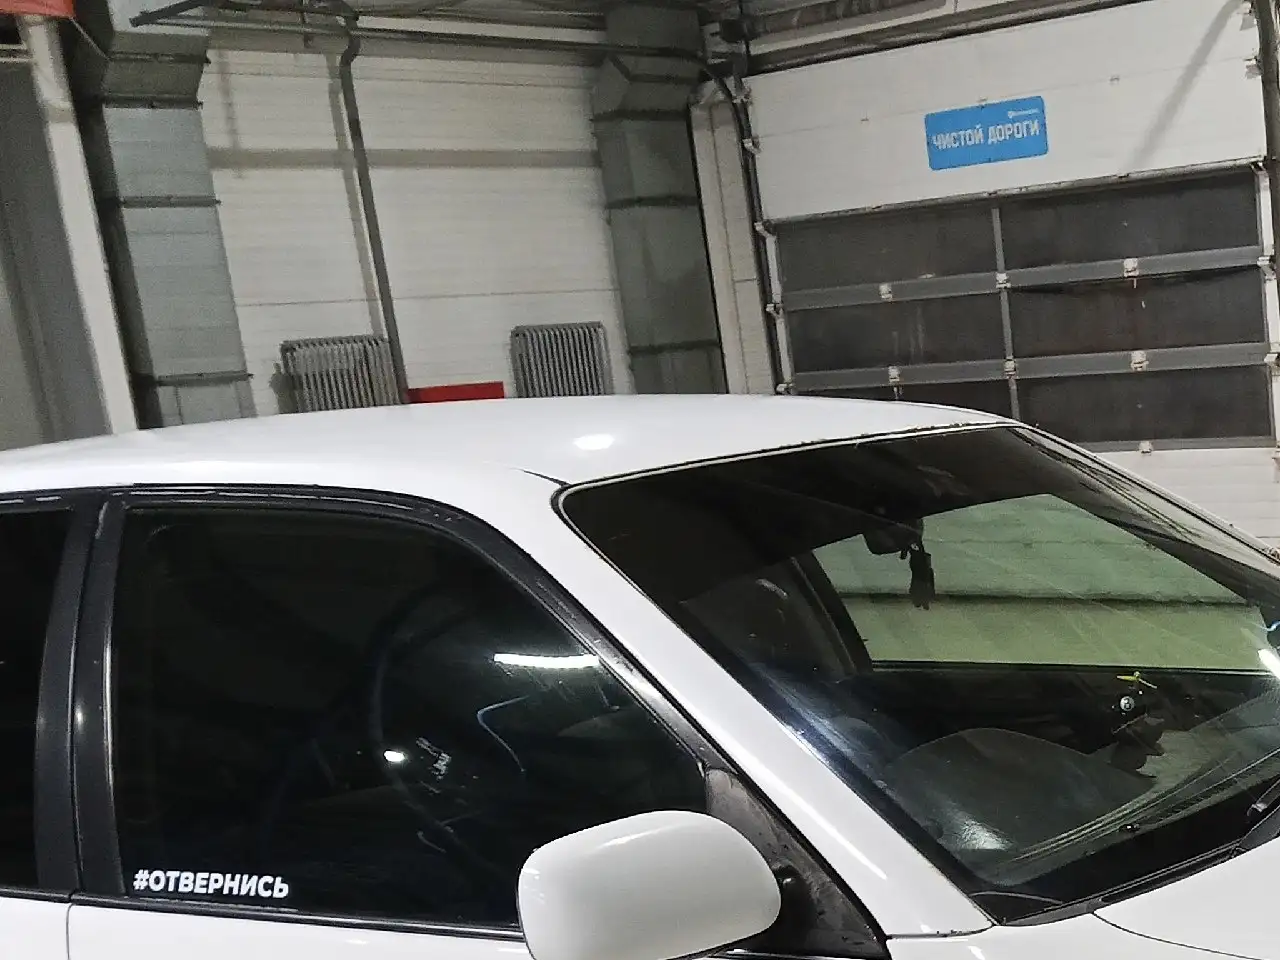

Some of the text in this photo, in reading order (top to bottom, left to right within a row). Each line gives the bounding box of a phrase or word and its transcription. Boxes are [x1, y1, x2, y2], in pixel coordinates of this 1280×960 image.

[932, 119, 1040, 149] ЧИСТОЙ ДОРОГИ
[133, 869, 289, 898] #ОТВЕРНИСЬ
